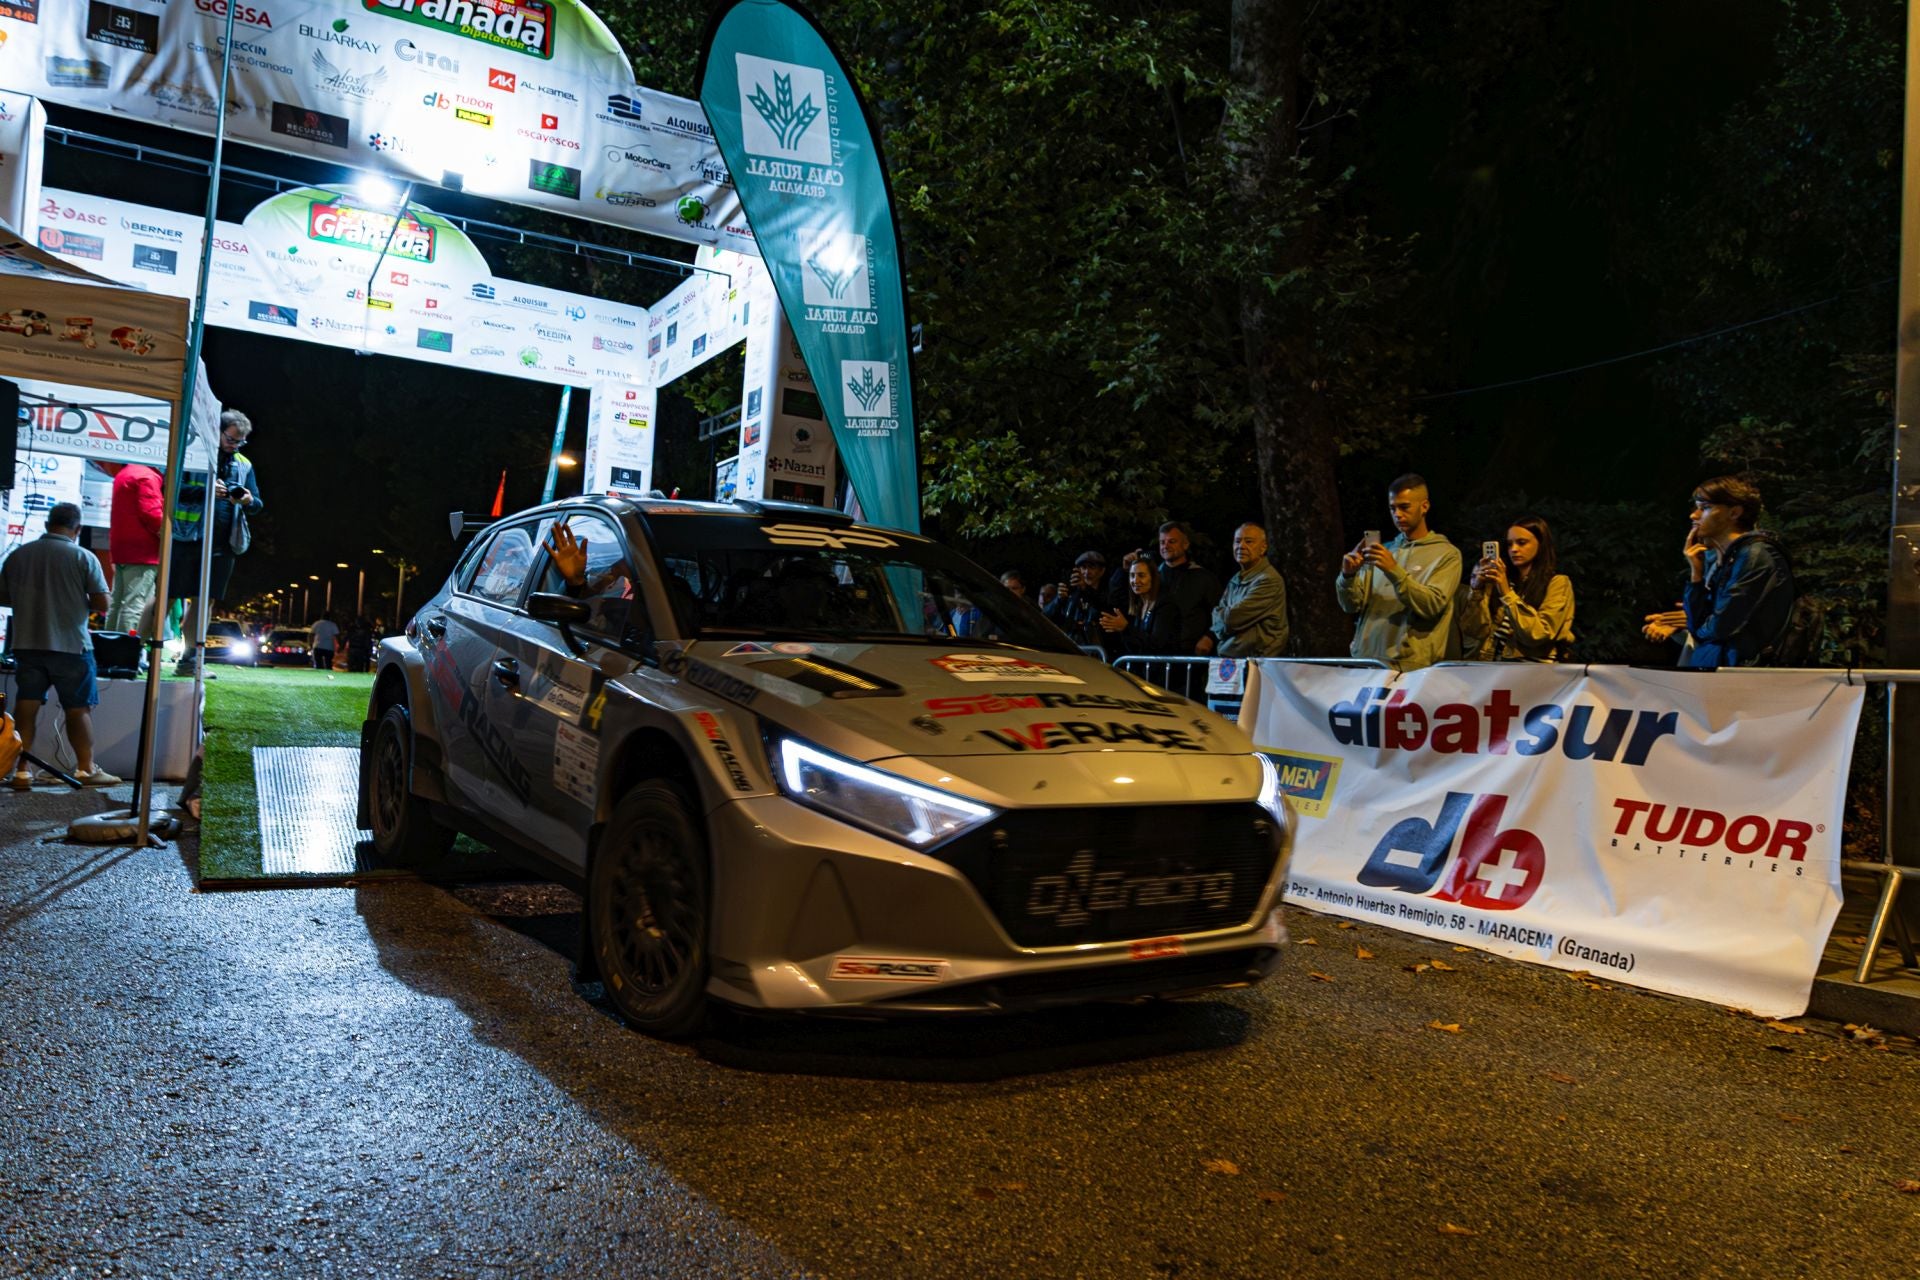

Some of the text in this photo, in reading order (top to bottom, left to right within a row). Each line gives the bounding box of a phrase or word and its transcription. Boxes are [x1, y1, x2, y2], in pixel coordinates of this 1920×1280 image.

[456, 94, 493, 110] TUDOR
[666, 116, 714, 136] ALQUISU
[516, 127, 581, 150] escayescos
[624, 151, 672, 171] MotorCars
[130, 221, 183, 239] BERNER
[512, 295, 549, 308] ALQUISUR
[536, 328, 573, 342] MEDINA
[1327, 686, 1679, 766] dibatsur
[1612, 797, 1815, 862] TUDOR
[1356, 790, 1547, 911] db
[1610, 838, 1804, 877] BATTERIES
[1291, 882, 1309, 898] Paz
[1316, 887, 1354, 907] Antonio
[1356, 894, 1396, 916] Huertas
[1399, 903, 1448, 930] Remigio,
[1450, 914, 1466, 931] 58
[1477, 919, 1554, 950] MARACENA
[1557, 935, 1636, 974] (Granada)
